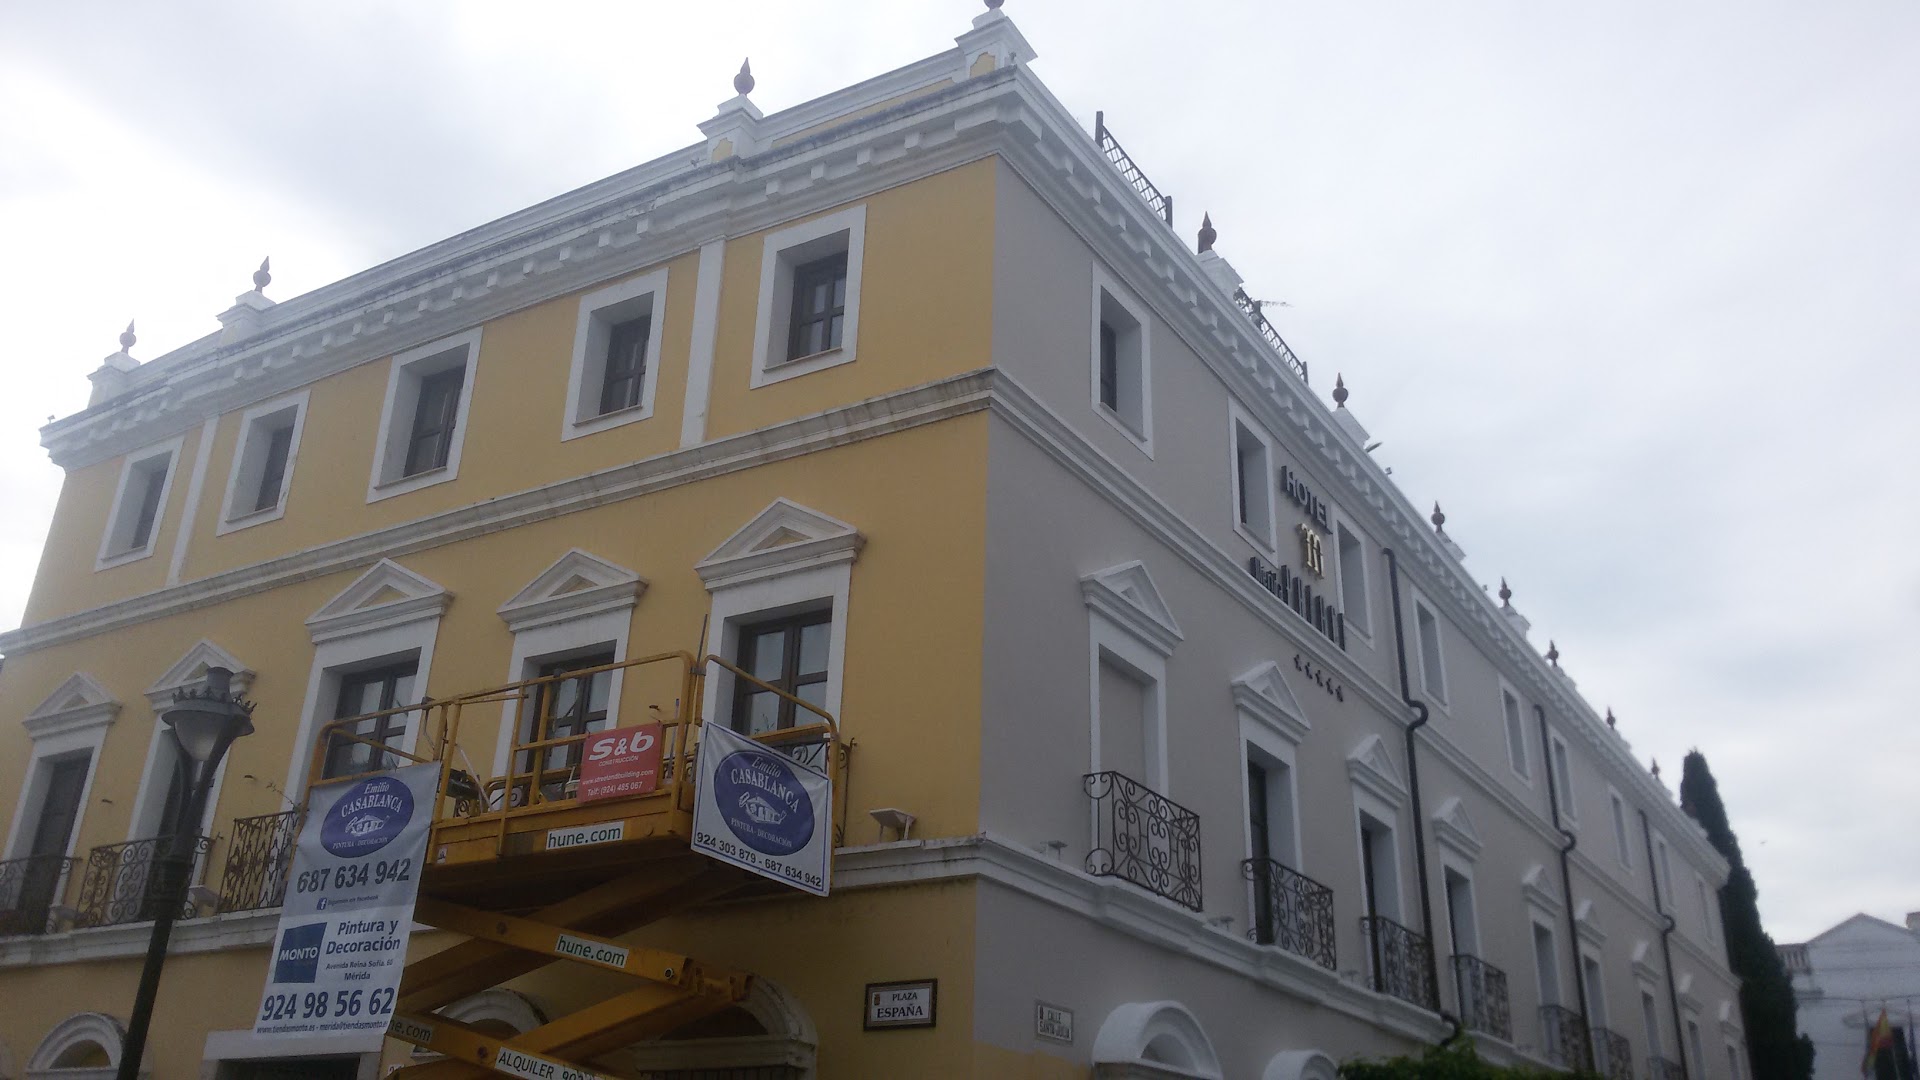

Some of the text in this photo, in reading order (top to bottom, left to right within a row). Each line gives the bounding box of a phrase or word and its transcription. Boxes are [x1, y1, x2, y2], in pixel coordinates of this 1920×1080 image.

[589, 731, 655, 760] S&b
[751, 756, 781, 779] Emilio
[364, 782, 390, 795] Emilio
[731, 768, 800, 813] CASABLANCA
[341, 794, 403, 818] CASABLANCA
[548, 827, 621, 848] hune.com
[730, 817, 754, 834] PINTURA
[757, 829, 792, 848] DECORACIÓN
[697, 832, 716, 848] 924
[719, 840, 736, 856] 303
[739, 848, 756, 864] 879
[765, 858, 782, 873] 687
[785, 865, 802, 881] 634
[805, 873, 821, 887] 942
[297, 858, 411, 893] 687 634 942
[337, 920, 399, 936] Pintura y
[279, 946, 319, 961] MONTO
[326, 936, 401, 955] Decoración
[557, 936, 625, 967] hune.com
[344, 971, 371, 981] Mérida
[262, 987, 395, 1021] 924 98 56 62
[893, 992, 918, 1001] PLAZA
[878, 1003, 924, 1018] ESPAÑA
[320, 1020, 389, 1030] merida@tiendasmonto.e
[498, 1052, 554, 1080] ALQUILER
